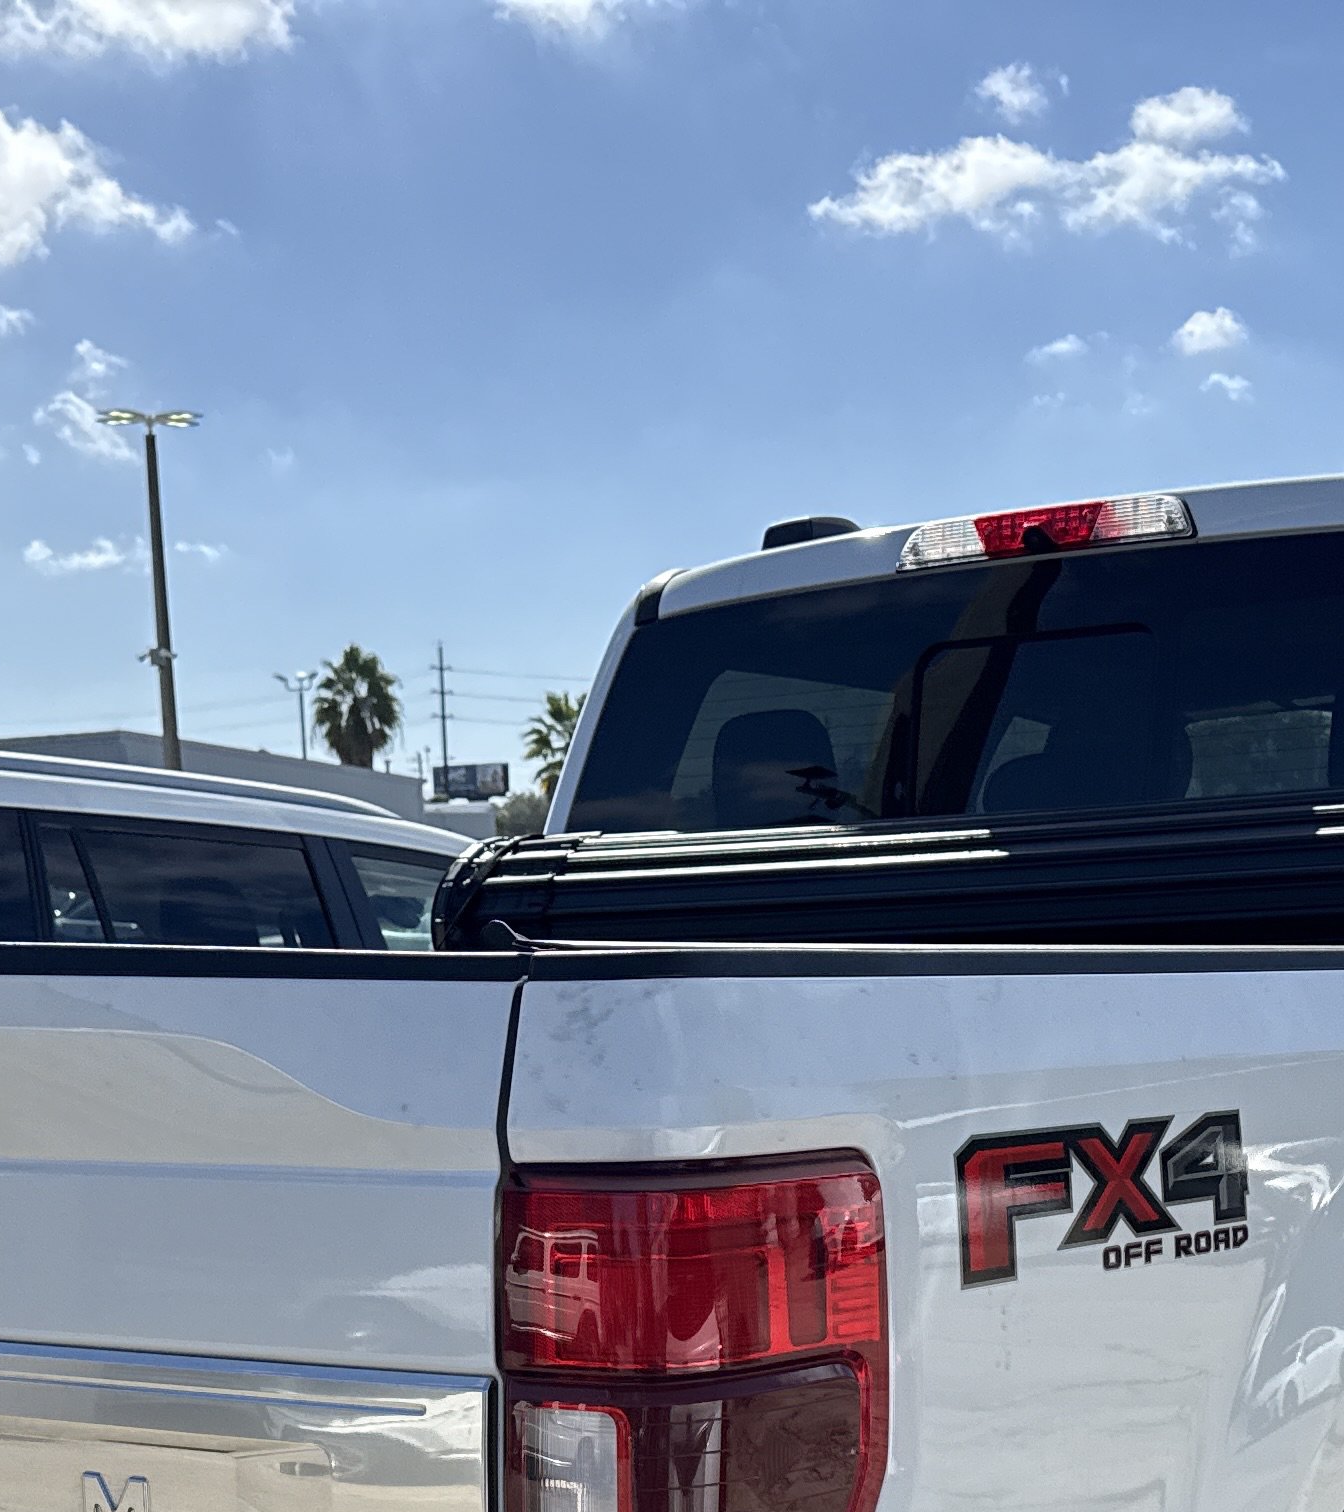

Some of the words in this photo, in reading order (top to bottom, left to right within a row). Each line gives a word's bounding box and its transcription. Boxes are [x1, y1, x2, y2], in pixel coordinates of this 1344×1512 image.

[954, 1109, 1249, 1290] FX4
[1102, 1238, 1163, 1271] OFF
[1175, 1224, 1249, 1259] ROAD
